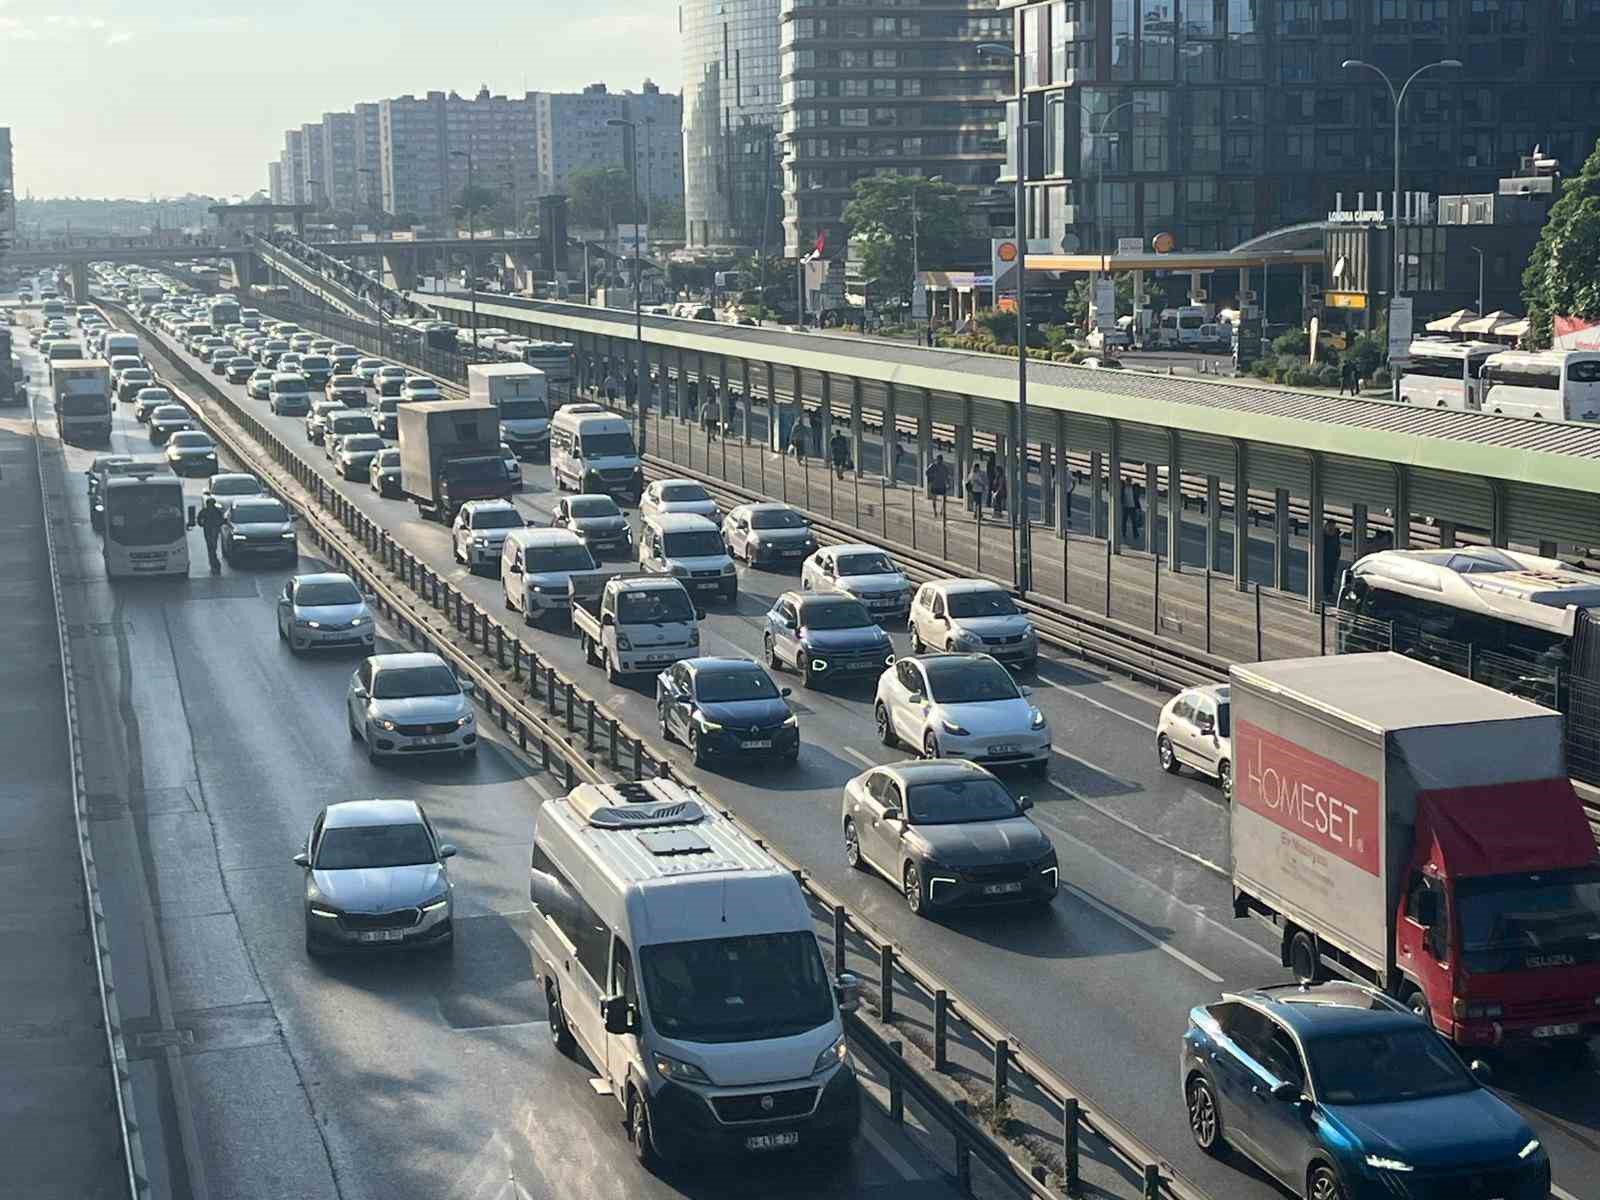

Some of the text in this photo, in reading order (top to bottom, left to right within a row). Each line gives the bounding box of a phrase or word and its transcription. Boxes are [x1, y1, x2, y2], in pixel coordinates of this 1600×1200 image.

[1354, 210, 1384, 222] CAMPING
[1248, 738, 1358, 849] HOMESET
[1525, 953, 1577, 968] ISUZU
